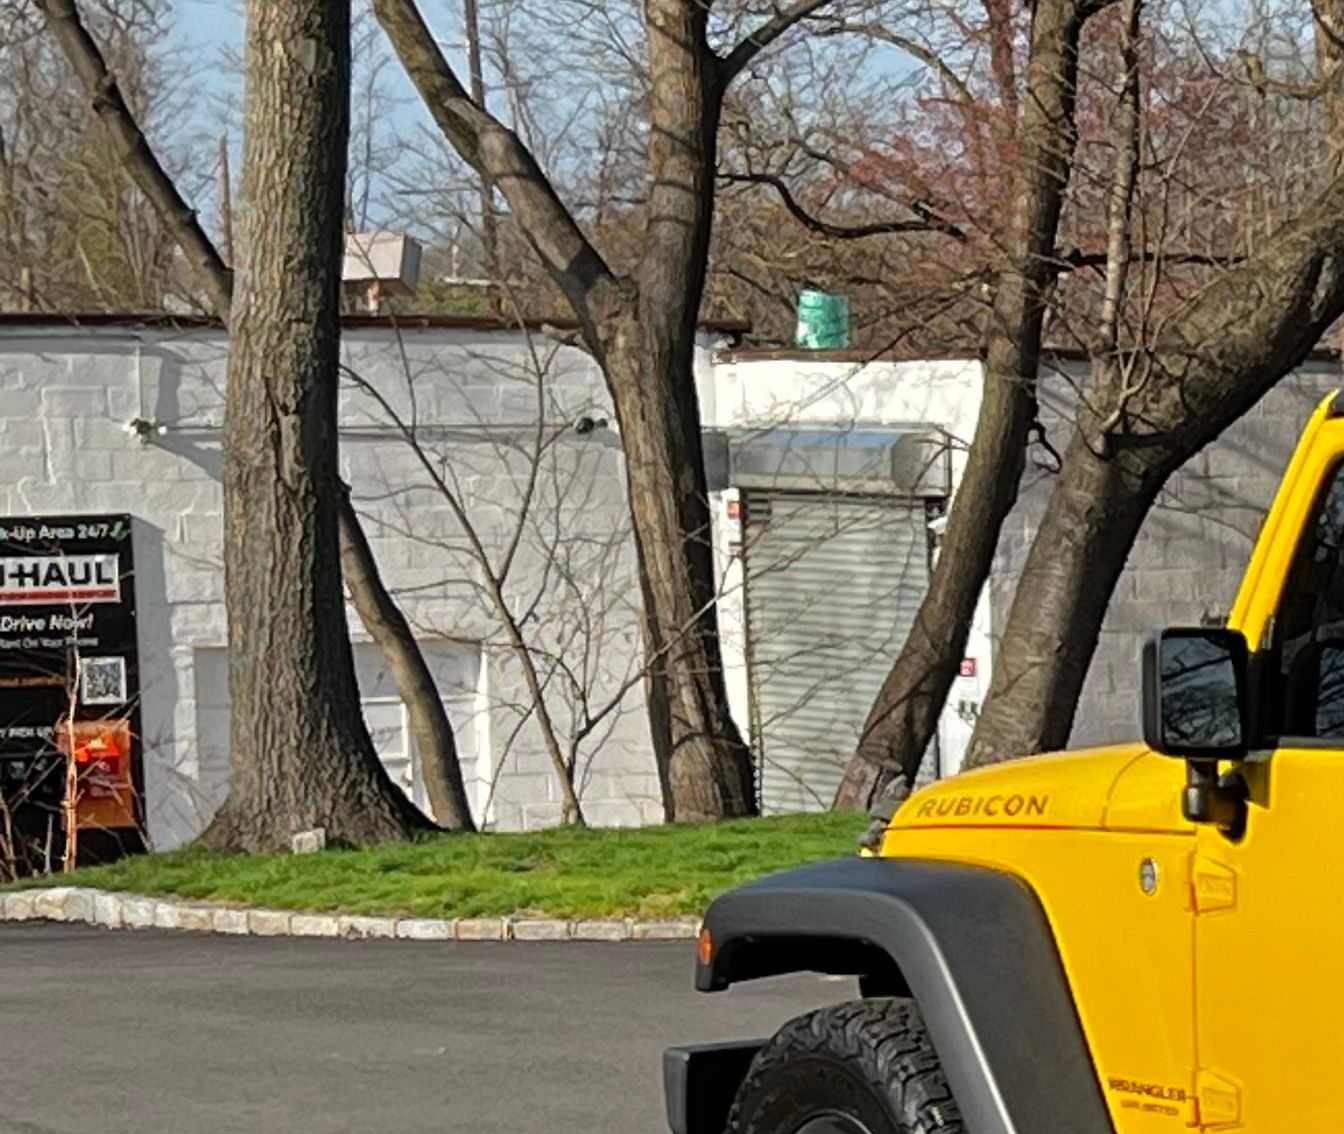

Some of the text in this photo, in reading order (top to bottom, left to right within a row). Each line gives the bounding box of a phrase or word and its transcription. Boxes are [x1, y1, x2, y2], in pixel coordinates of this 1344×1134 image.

[39, 524, 75, 539] Area
[78, 523, 109, 539] 24/7
[0, 562, 114, 587] -HAUL
[0, 612, 94, 632] Drive Now!
[916, 794, 1049, 818] RUBICON
